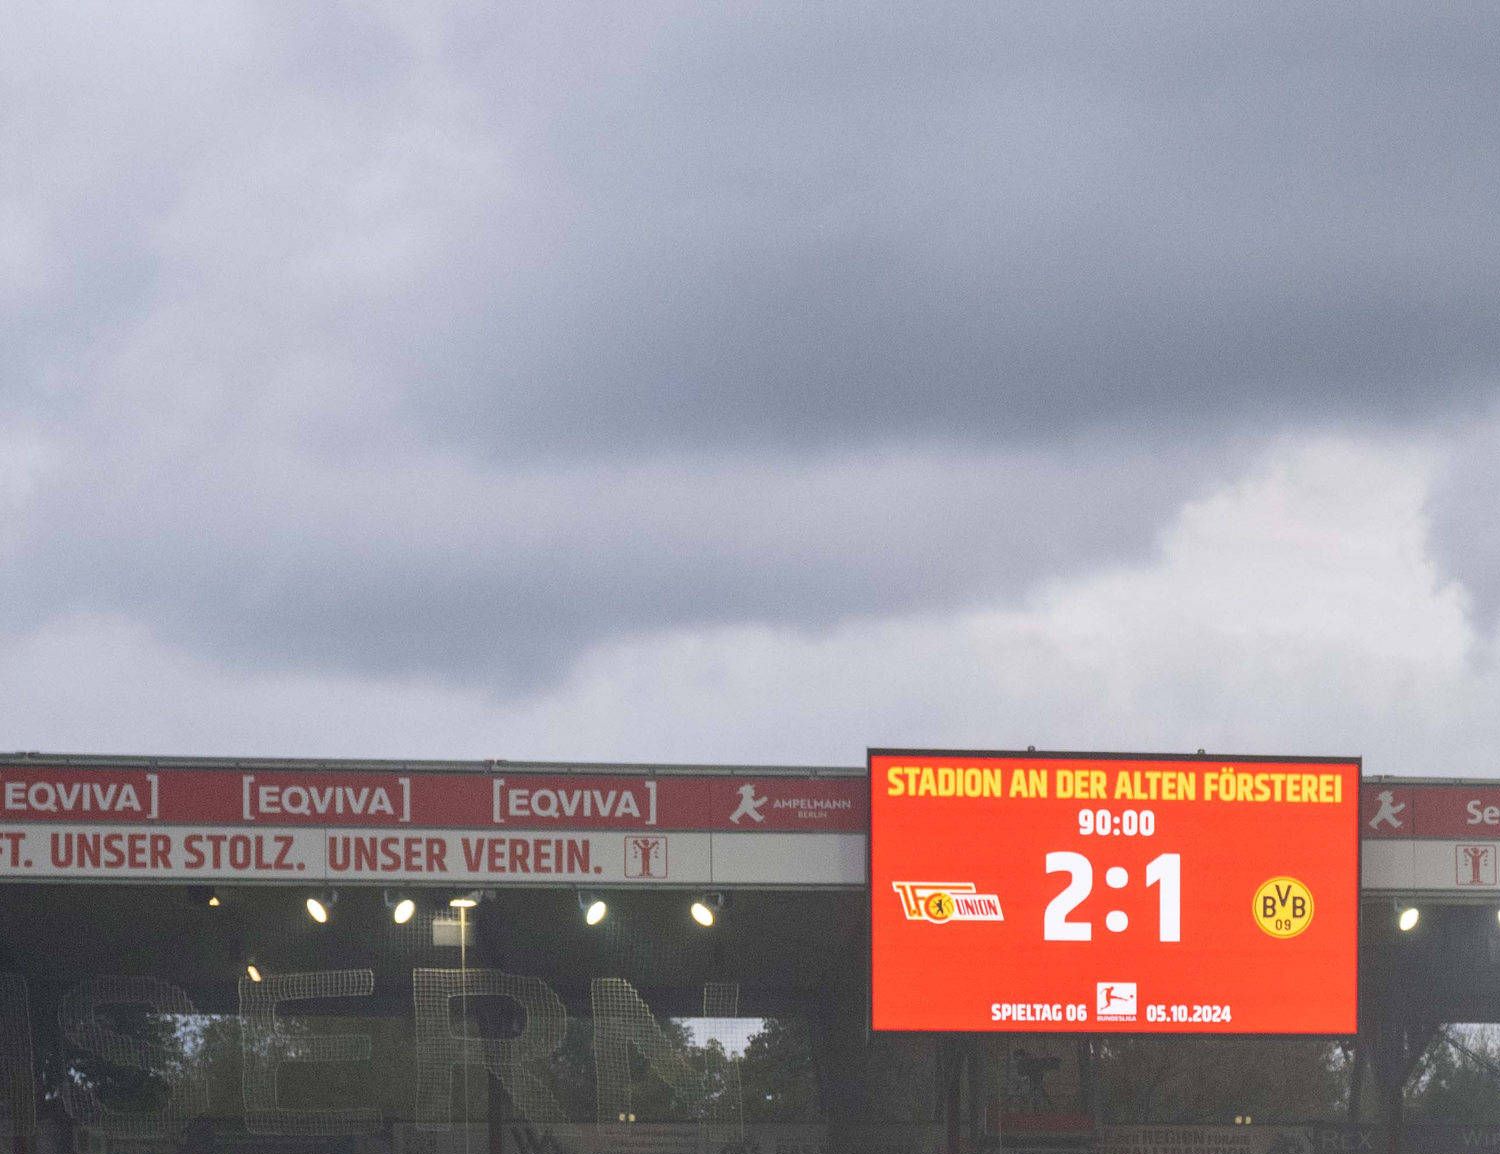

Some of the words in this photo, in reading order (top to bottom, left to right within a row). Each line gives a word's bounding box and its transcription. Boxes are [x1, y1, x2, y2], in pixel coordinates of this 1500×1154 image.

[887, 767, 1003, 798] STADION
[1009, 770, 1048, 799] AN
[1056, 770, 1107, 800] DER
[1114, 771, 1196, 801] ALTEN
[1203, 771, 1343, 804] FÖRSTEREI
[773, 798, 852, 811] AMPELMANN
[1078, 808, 1156, 837] 90:00
[50, 833, 173, 870] UNSER
[184, 834, 306, 871] STOLZ.
[328, 836, 448, 873] UNSER
[461, 838, 603, 874] VEREIN.
[955, 898, 999, 916] UNION
[1043, 851, 1182, 943] 2:1
[1262, 884, 1306, 919] BVB
[1275, 918, 1292, 931] 09
[991, 1003, 1063, 1022] SPIELTAG
[1066, 1003, 1088, 1022] 06
[1146, 1004, 1233, 1023] 05.10.2024
